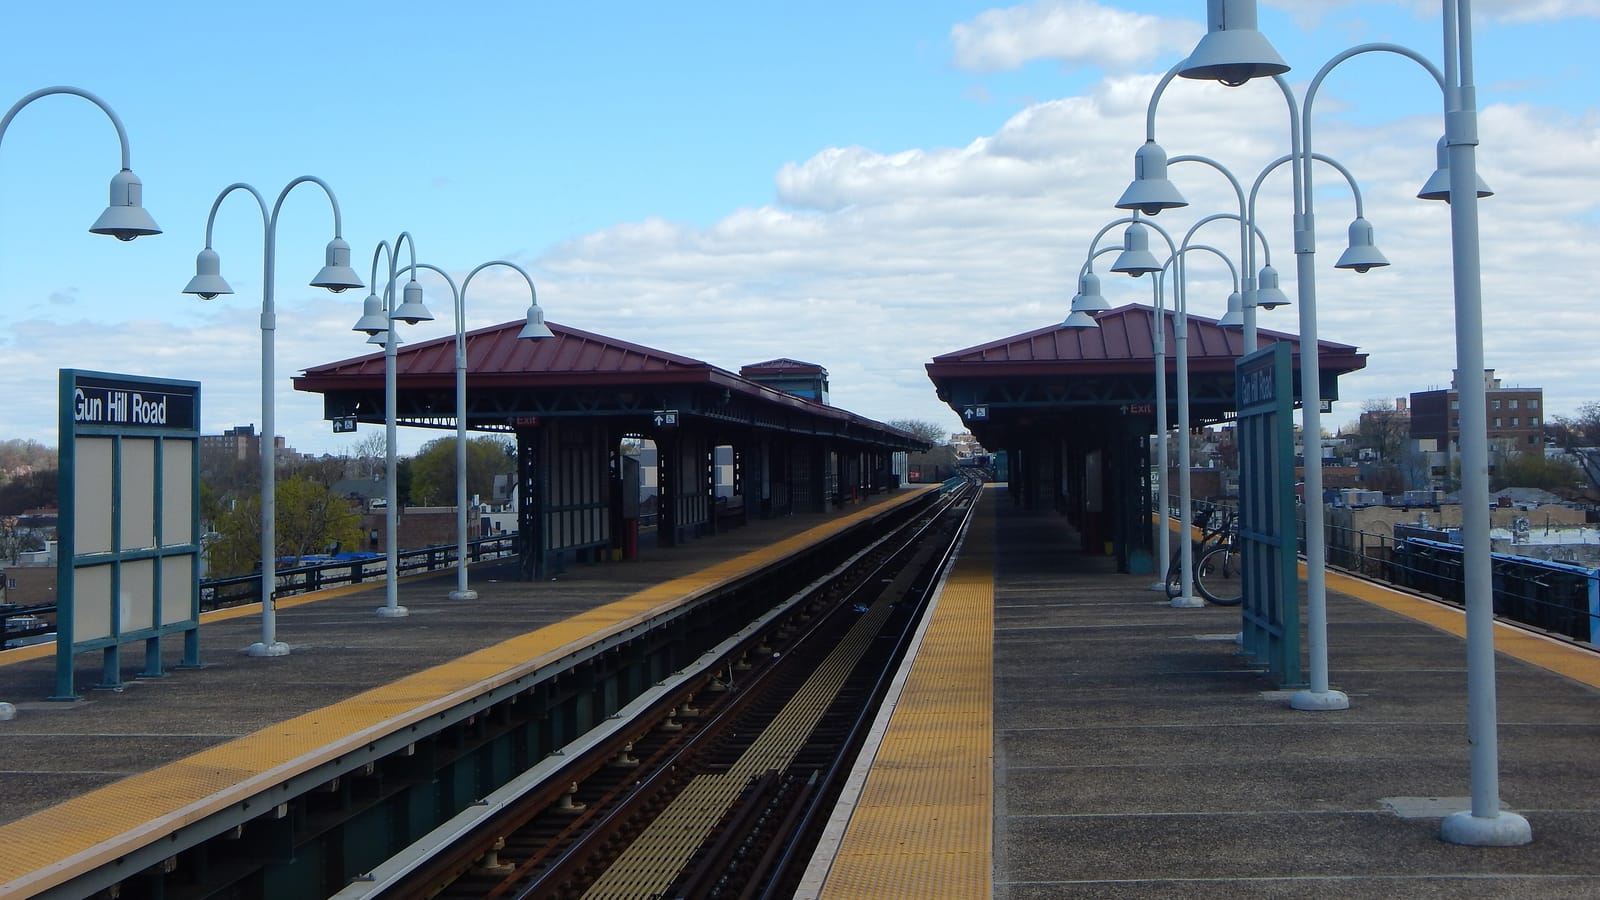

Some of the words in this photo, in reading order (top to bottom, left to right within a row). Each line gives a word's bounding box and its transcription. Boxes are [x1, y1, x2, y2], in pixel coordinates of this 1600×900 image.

[1259, 367, 1272, 400] Road
[75, 388, 102, 421] Gun
[108, 391, 128, 422] Hill
[132, 393, 167, 424] Road
[1130, 404, 1152, 414] Exit
[516, 416, 537, 425] Exit
